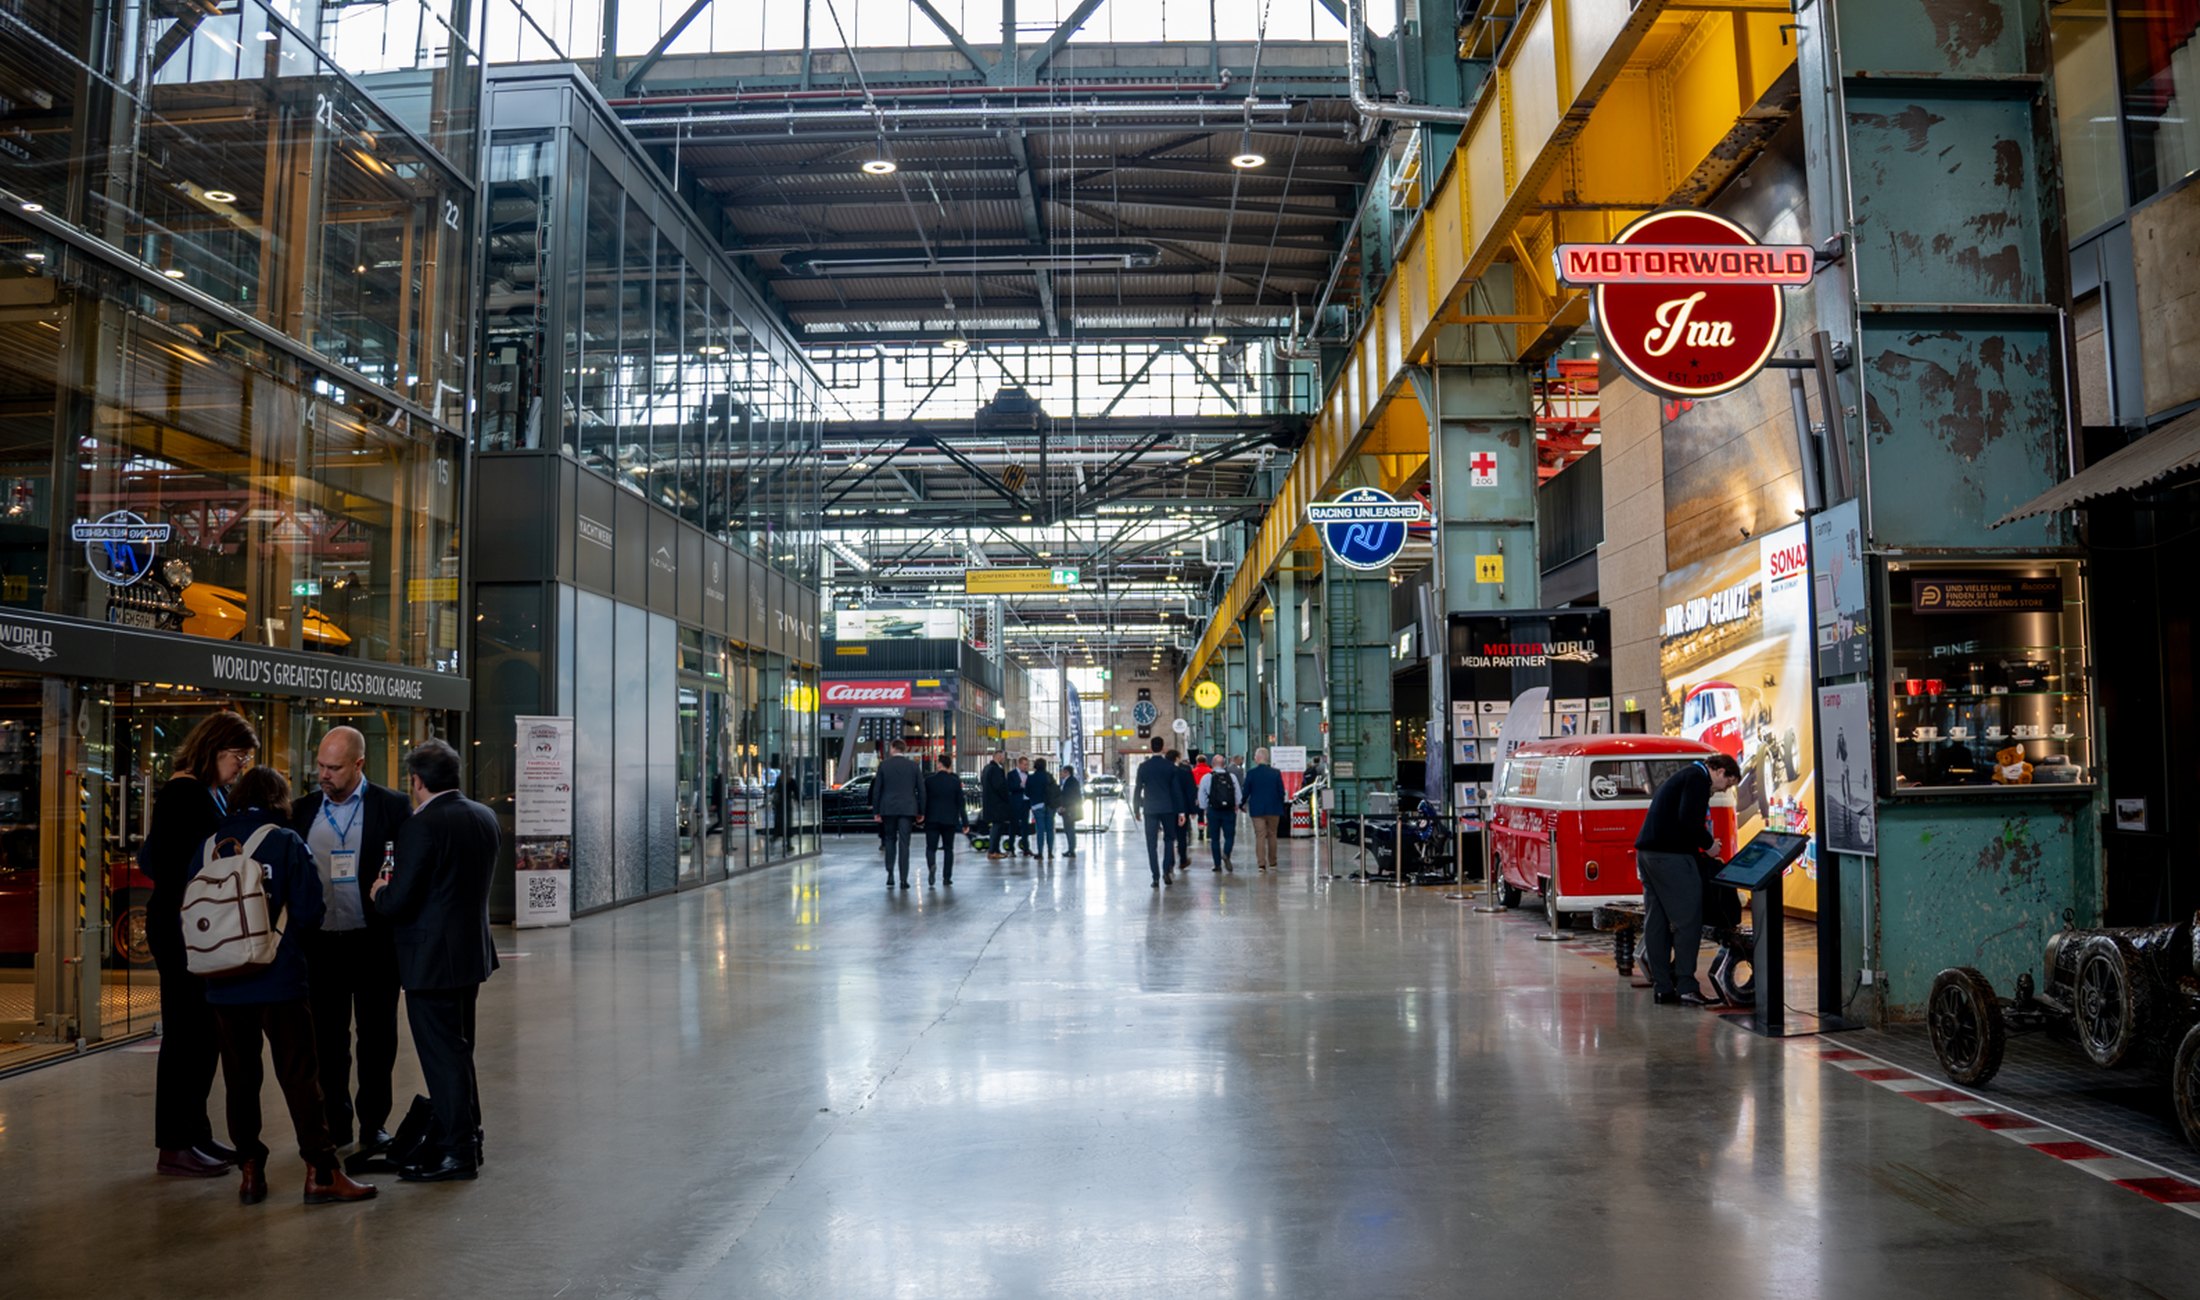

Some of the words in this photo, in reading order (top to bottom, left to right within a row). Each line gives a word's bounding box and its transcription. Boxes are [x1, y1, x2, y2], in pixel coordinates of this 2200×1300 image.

[316, 93, 333, 130] 21
[445, 199, 460, 231] 22
[1570, 251, 1808, 275] MOTORWORLD
[1643, 290, 1736, 357] Inn
[1667, 371, 1692, 385] EST.
[1696, 371, 1725, 385] 2020
[300, 396, 317, 430] 14
[436, 457, 449, 486] 15
[1312, 508, 1353, 519] RACING
[1354, 506, 1419, 518] UNLEASHED
[1945, 584, 1963, 592] UND
[1964, 584, 1989, 592] VIELES
[1990, 584, 2013, 592] MEHR
[1946, 592, 1975, 600] FINDEN
[1976, 592, 1988, 600] SIE
[1666, 603, 1684, 637] WIR
[1686, 596, 1708, 631] SIND
[1710, 583, 1750, 625] GLANZ!
[1946, 599, 2018, 608] PADDOCK-LEGENDS
[2020, 599, 2044, 607] STORE
[775, 609, 814, 642] RIMAC
[1483, 639, 1595, 656] MOTORWORLD
[1461, 655, 1491, 668] MEDIA
[1492, 655, 1546, 667] PARTNER
[212, 654, 272, 684] WORLD'S
[273, 663, 330, 690] GREATEST
[330, 670, 364, 694] GLASS
[365, 674, 387, 696] BOX
[387, 677, 423, 700] GARAGE
[826, 683, 906, 701] Carrera
